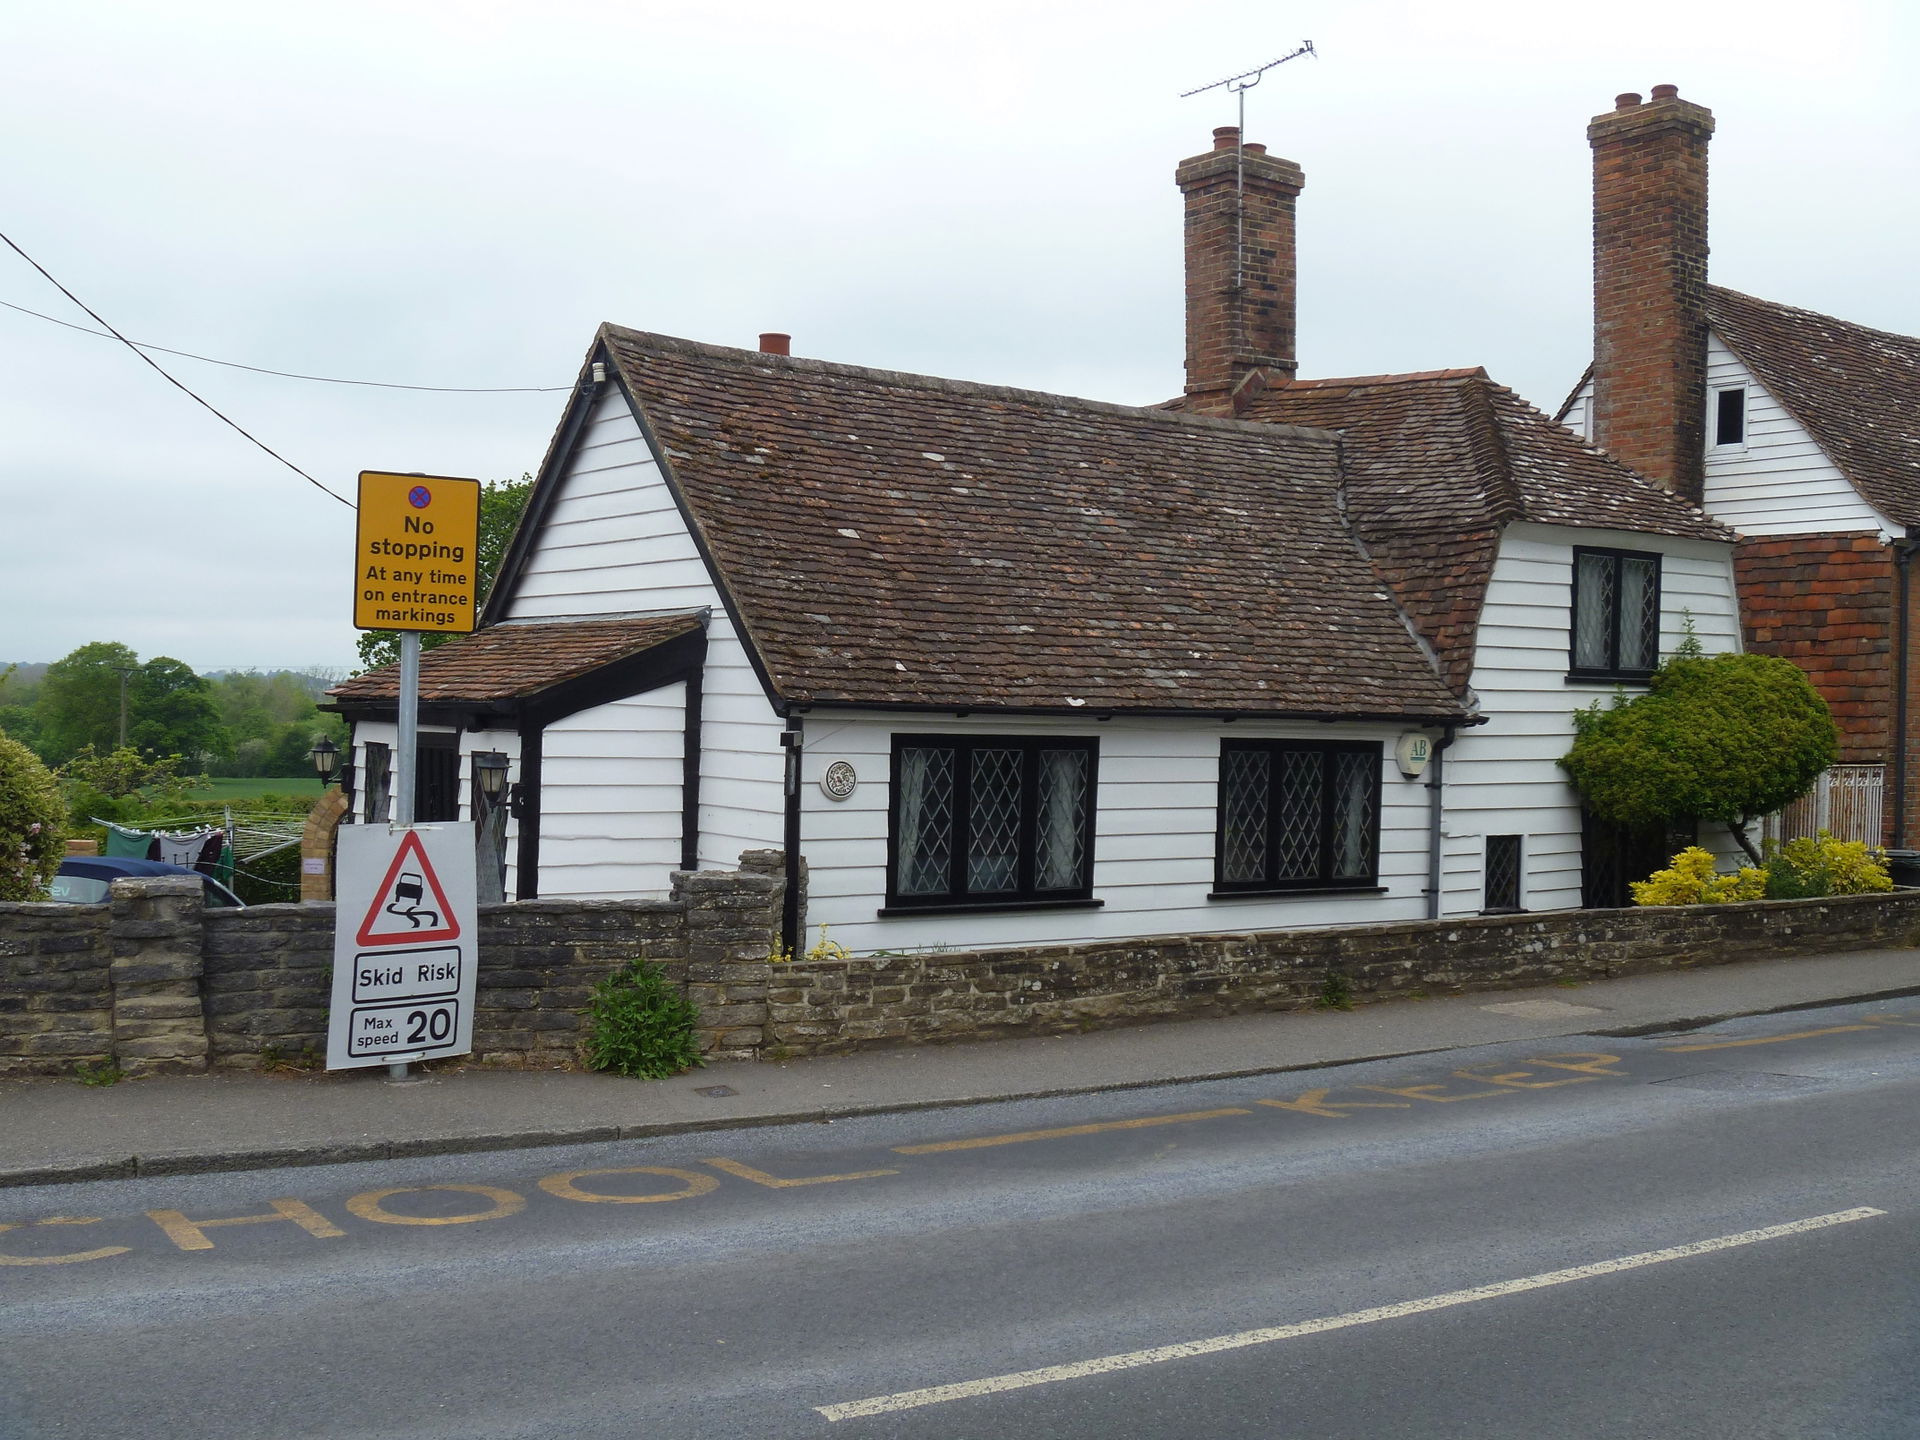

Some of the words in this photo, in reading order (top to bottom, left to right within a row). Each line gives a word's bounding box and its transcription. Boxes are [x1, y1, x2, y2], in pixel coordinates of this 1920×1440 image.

[404, 516, 434, 534] No
[370, 538, 464, 562] stopping
[366, 566, 387, 580] At
[393, 570, 423, 585] any
[430, 569, 467, 584] time
[364, 590, 385, 601] on
[391, 589, 468, 605] entrance
[376, 608, 455, 625] markings
[1410, 739, 1427, 756] AB
[359, 967, 403, 987] Skid
[418, 963, 456, 982] Risk
[364, 1017, 393, 1030] Max
[407, 1008, 451, 1044] 20
[357, 1032, 398, 1048] speed
